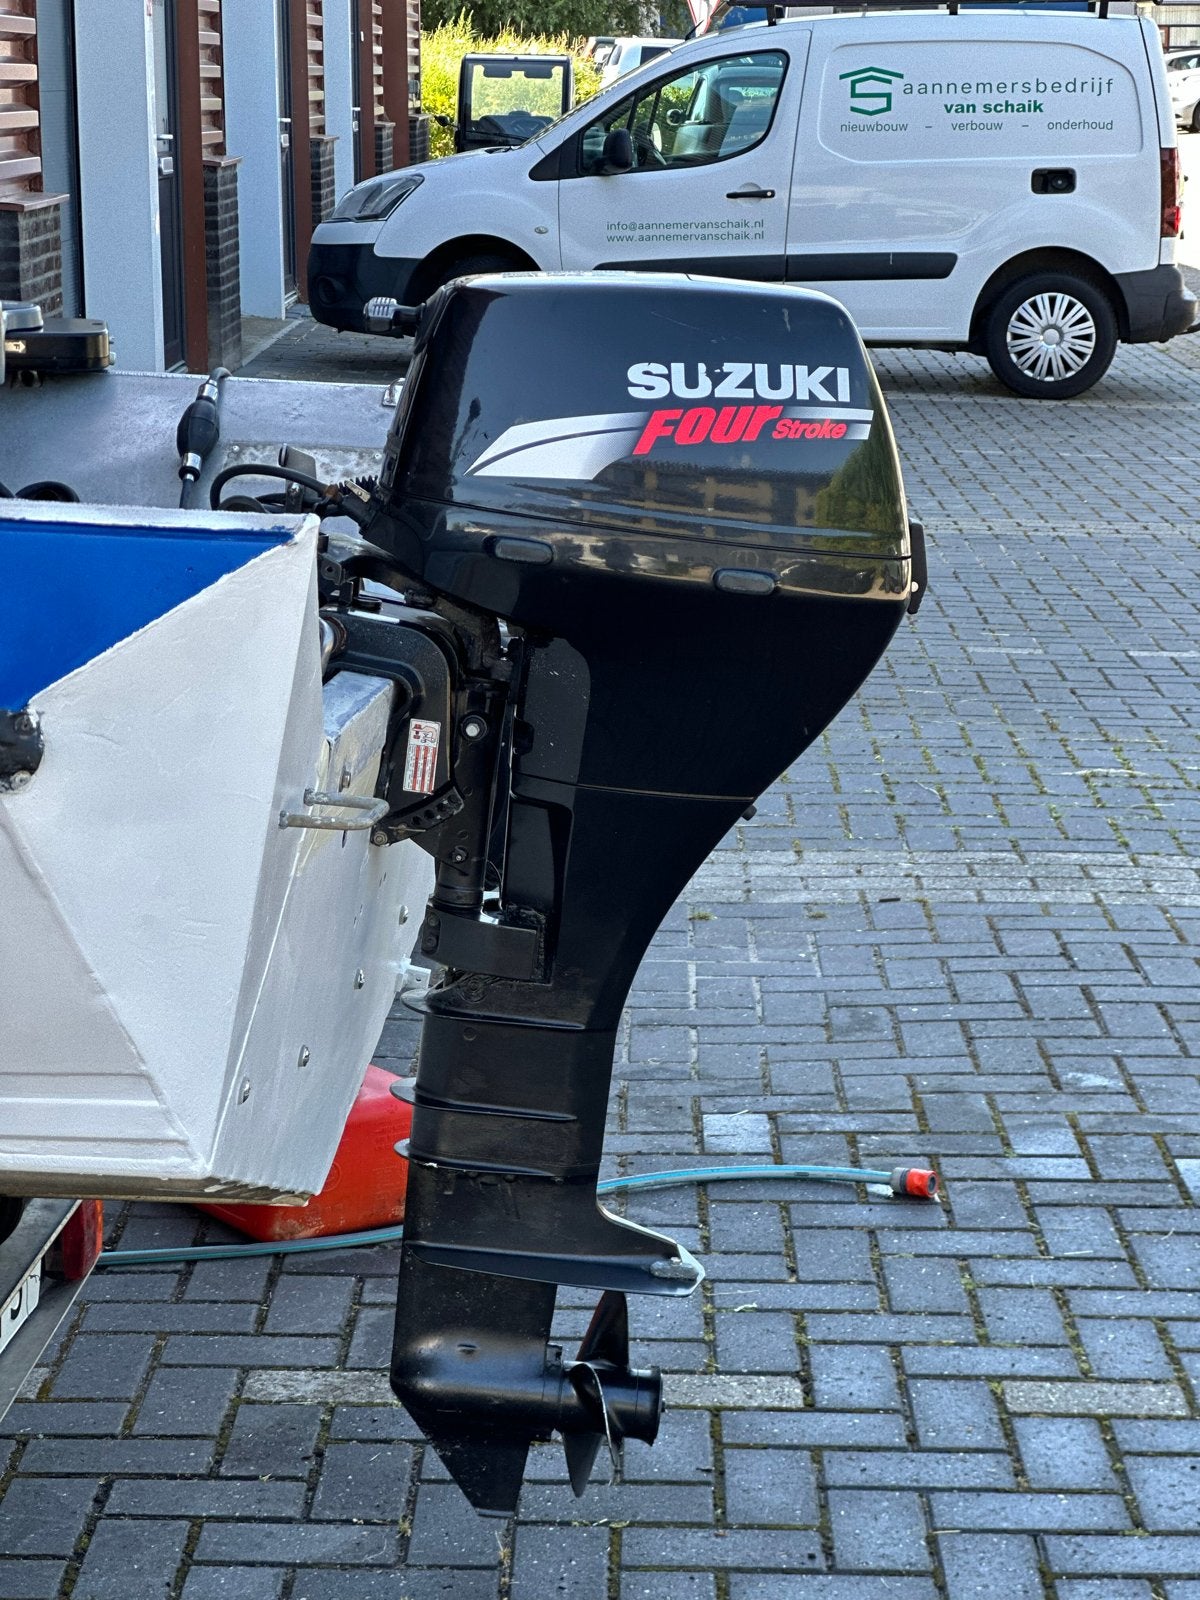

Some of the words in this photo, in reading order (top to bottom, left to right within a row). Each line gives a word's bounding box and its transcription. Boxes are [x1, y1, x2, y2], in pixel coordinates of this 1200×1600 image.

[902, 78, 1114, 97] aannemersbedrijf
[943, 103, 976, 114] van
[982, 100, 1044, 114] schaik
[840, 120, 909, 132] nieuwbouw
[951, 119, 1004, 131] verbouw
[1047, 119, 1114, 131] onderhoud
[606, 219, 764, 231] info@aannemervanschaik.nl
[606, 231, 765, 242] www.aannemervanschaik.nl
[626, 362, 850, 402] SUZUKI
[771, 418, 848, 440] Stroke
